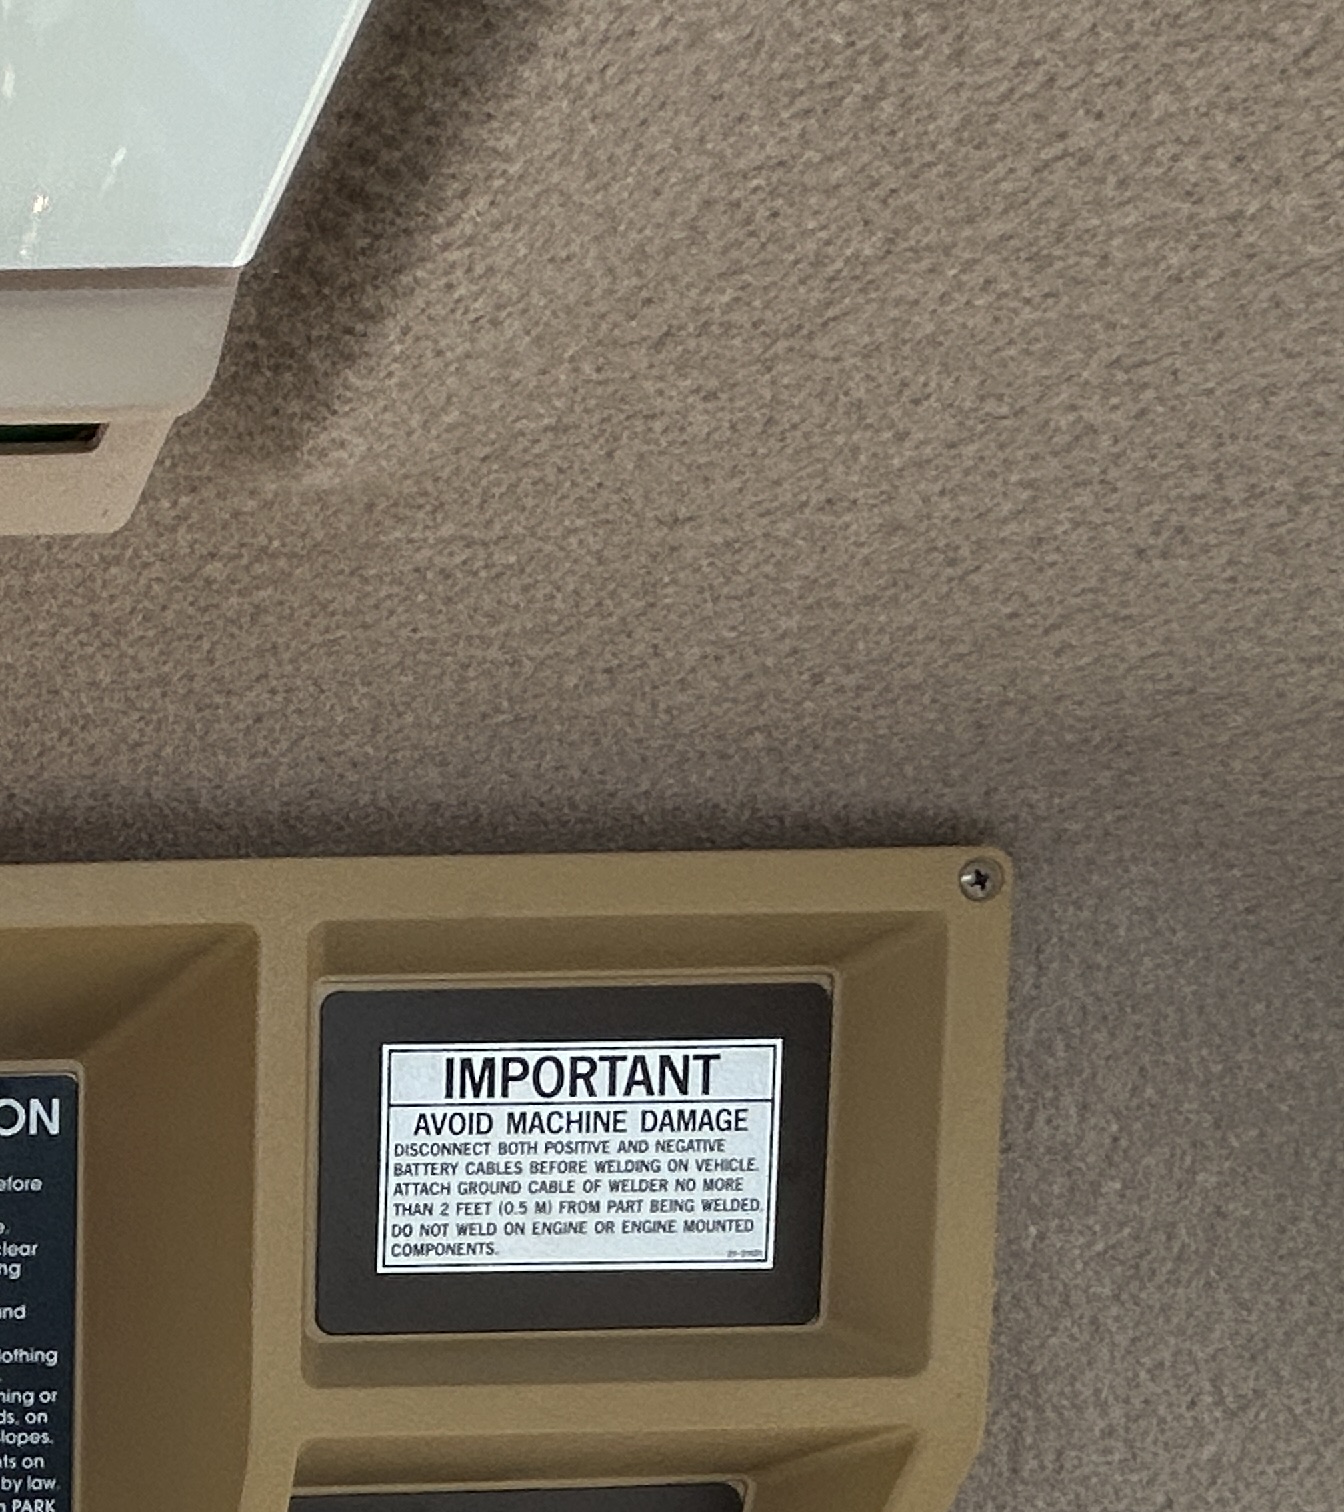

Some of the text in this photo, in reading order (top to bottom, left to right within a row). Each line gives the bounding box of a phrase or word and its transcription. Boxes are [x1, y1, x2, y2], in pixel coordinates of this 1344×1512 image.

[444, 1054, 721, 1099] IMPORTANT
[414, 1109, 749, 1136] AVOID MACHINE DAMAGE
[394, 1139, 725, 1157] DISCONNECT BOTH POSITIVE AND NEGATIVE
[393, 1158, 759, 1177] BATTERY CABLES BEFORE WELDING ON VEHICLE.
[393, 1177, 743, 1196] ATTACH GROUND CABLE OF WELDER NO MORE
[393, 1198, 762, 1216] THAN 2 FEET (0.5 M) FROM PART BEING WELDED.
[392, 1219, 753, 1237] DO NOT WELD ON ENGINE OR ENGINE MOUNTED
[390, 1243, 499, 1257] COMPONENTS.
